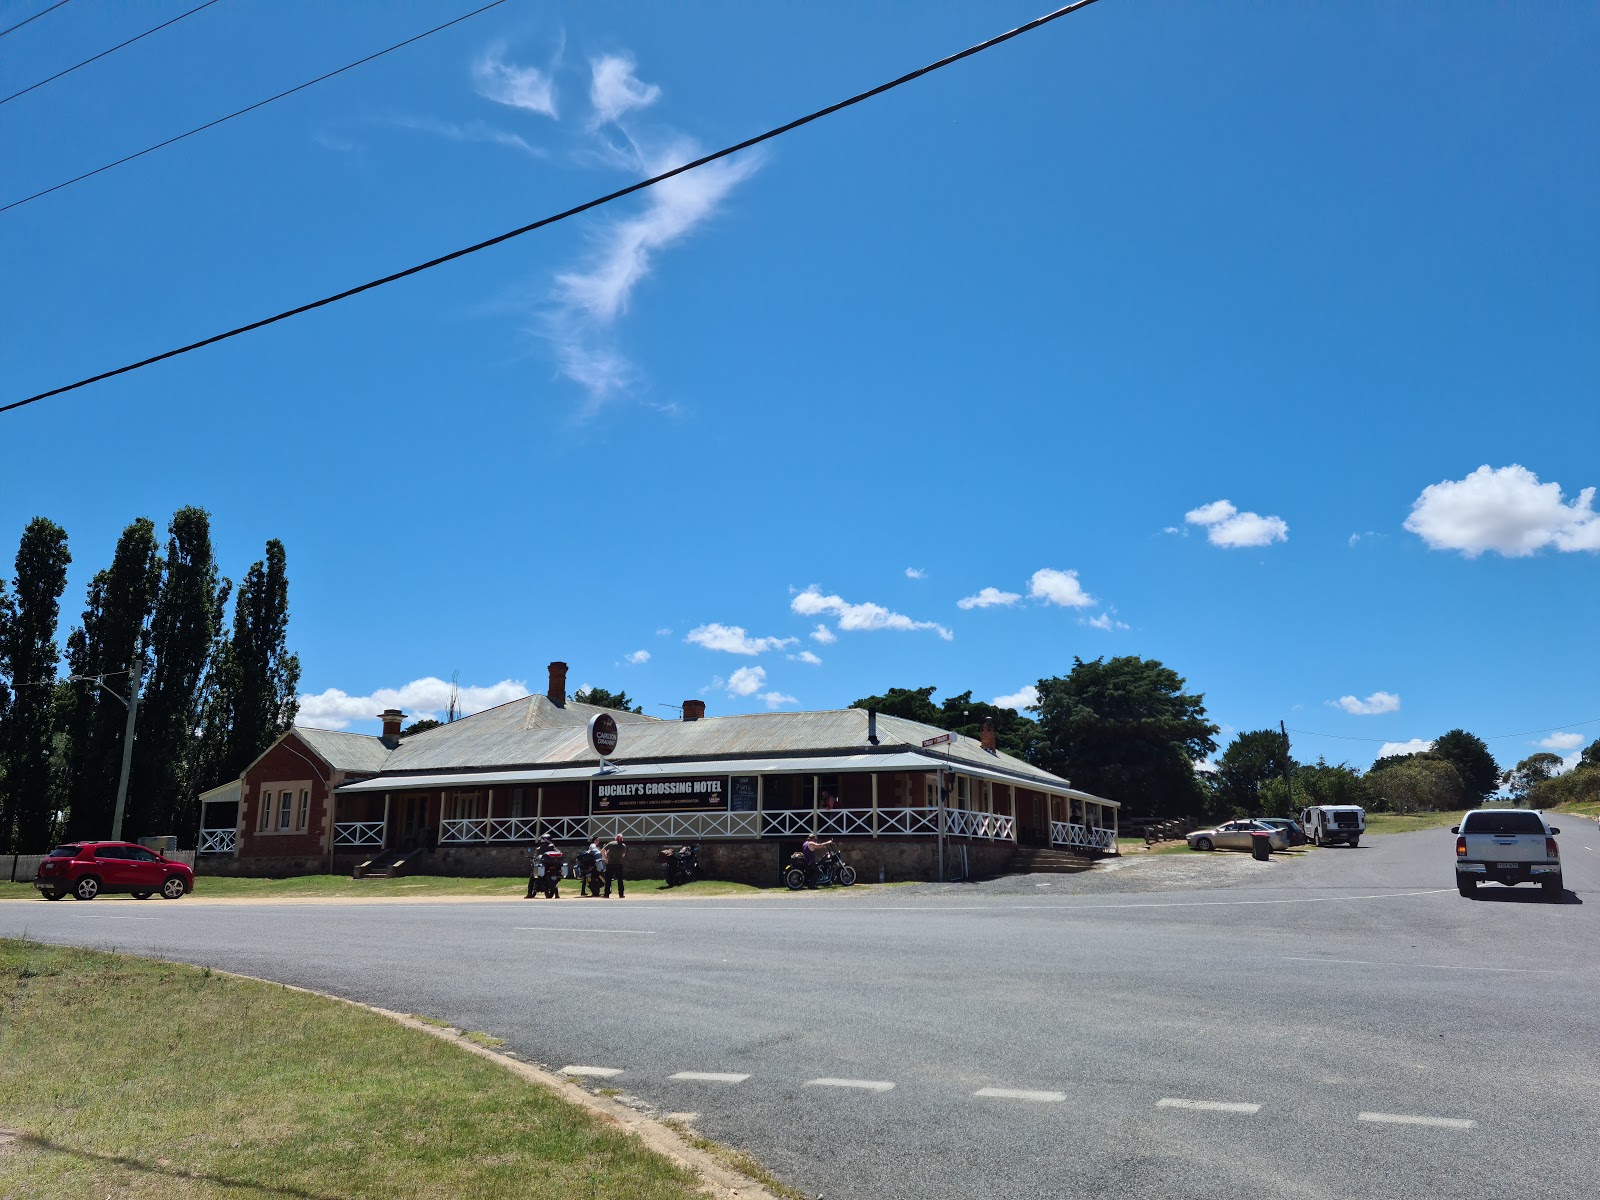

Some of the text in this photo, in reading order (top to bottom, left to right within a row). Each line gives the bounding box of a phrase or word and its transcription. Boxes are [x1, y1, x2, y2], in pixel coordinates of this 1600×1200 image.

[596, 731, 617, 741] CARLTON
[598, 780, 722, 797] BUCKLEY'S CROSSING HOTEL
